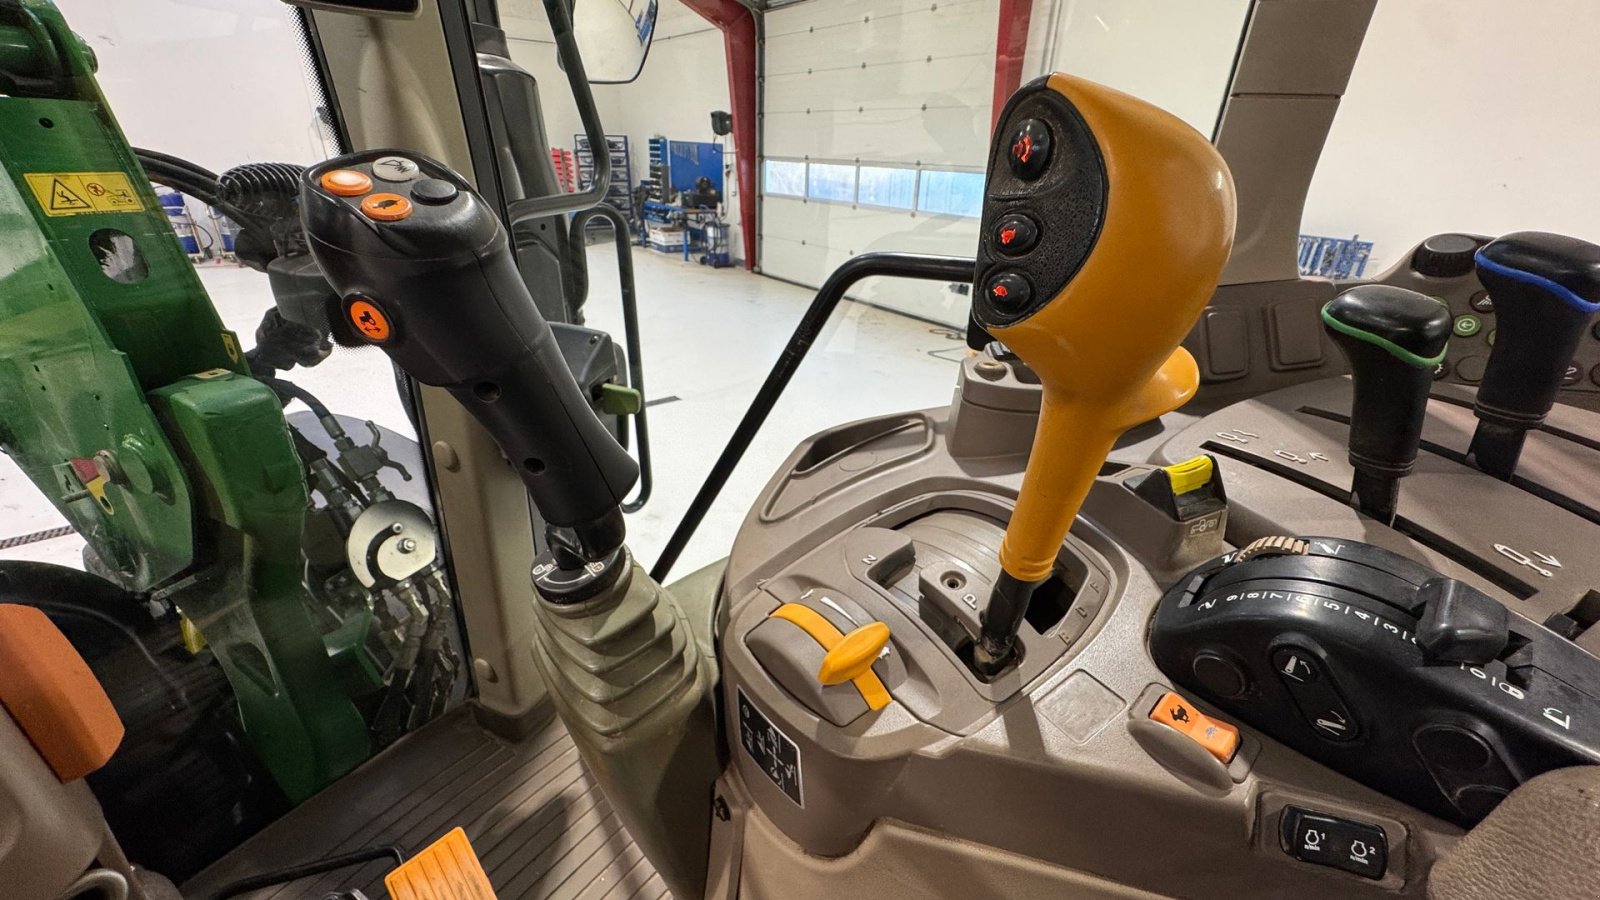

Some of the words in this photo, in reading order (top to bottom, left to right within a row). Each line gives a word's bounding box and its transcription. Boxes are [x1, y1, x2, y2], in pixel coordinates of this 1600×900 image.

[861, 553, 877, 565] N
[961, 593, 977, 610] P
[1323, 601, 1340, 610] 5
[1354, 610, 1371, 621] 4
[1382, 623, 1399, 634] 3
[1321, 832, 1326, 840] 1
[1369, 846, 1375, 855] 2
